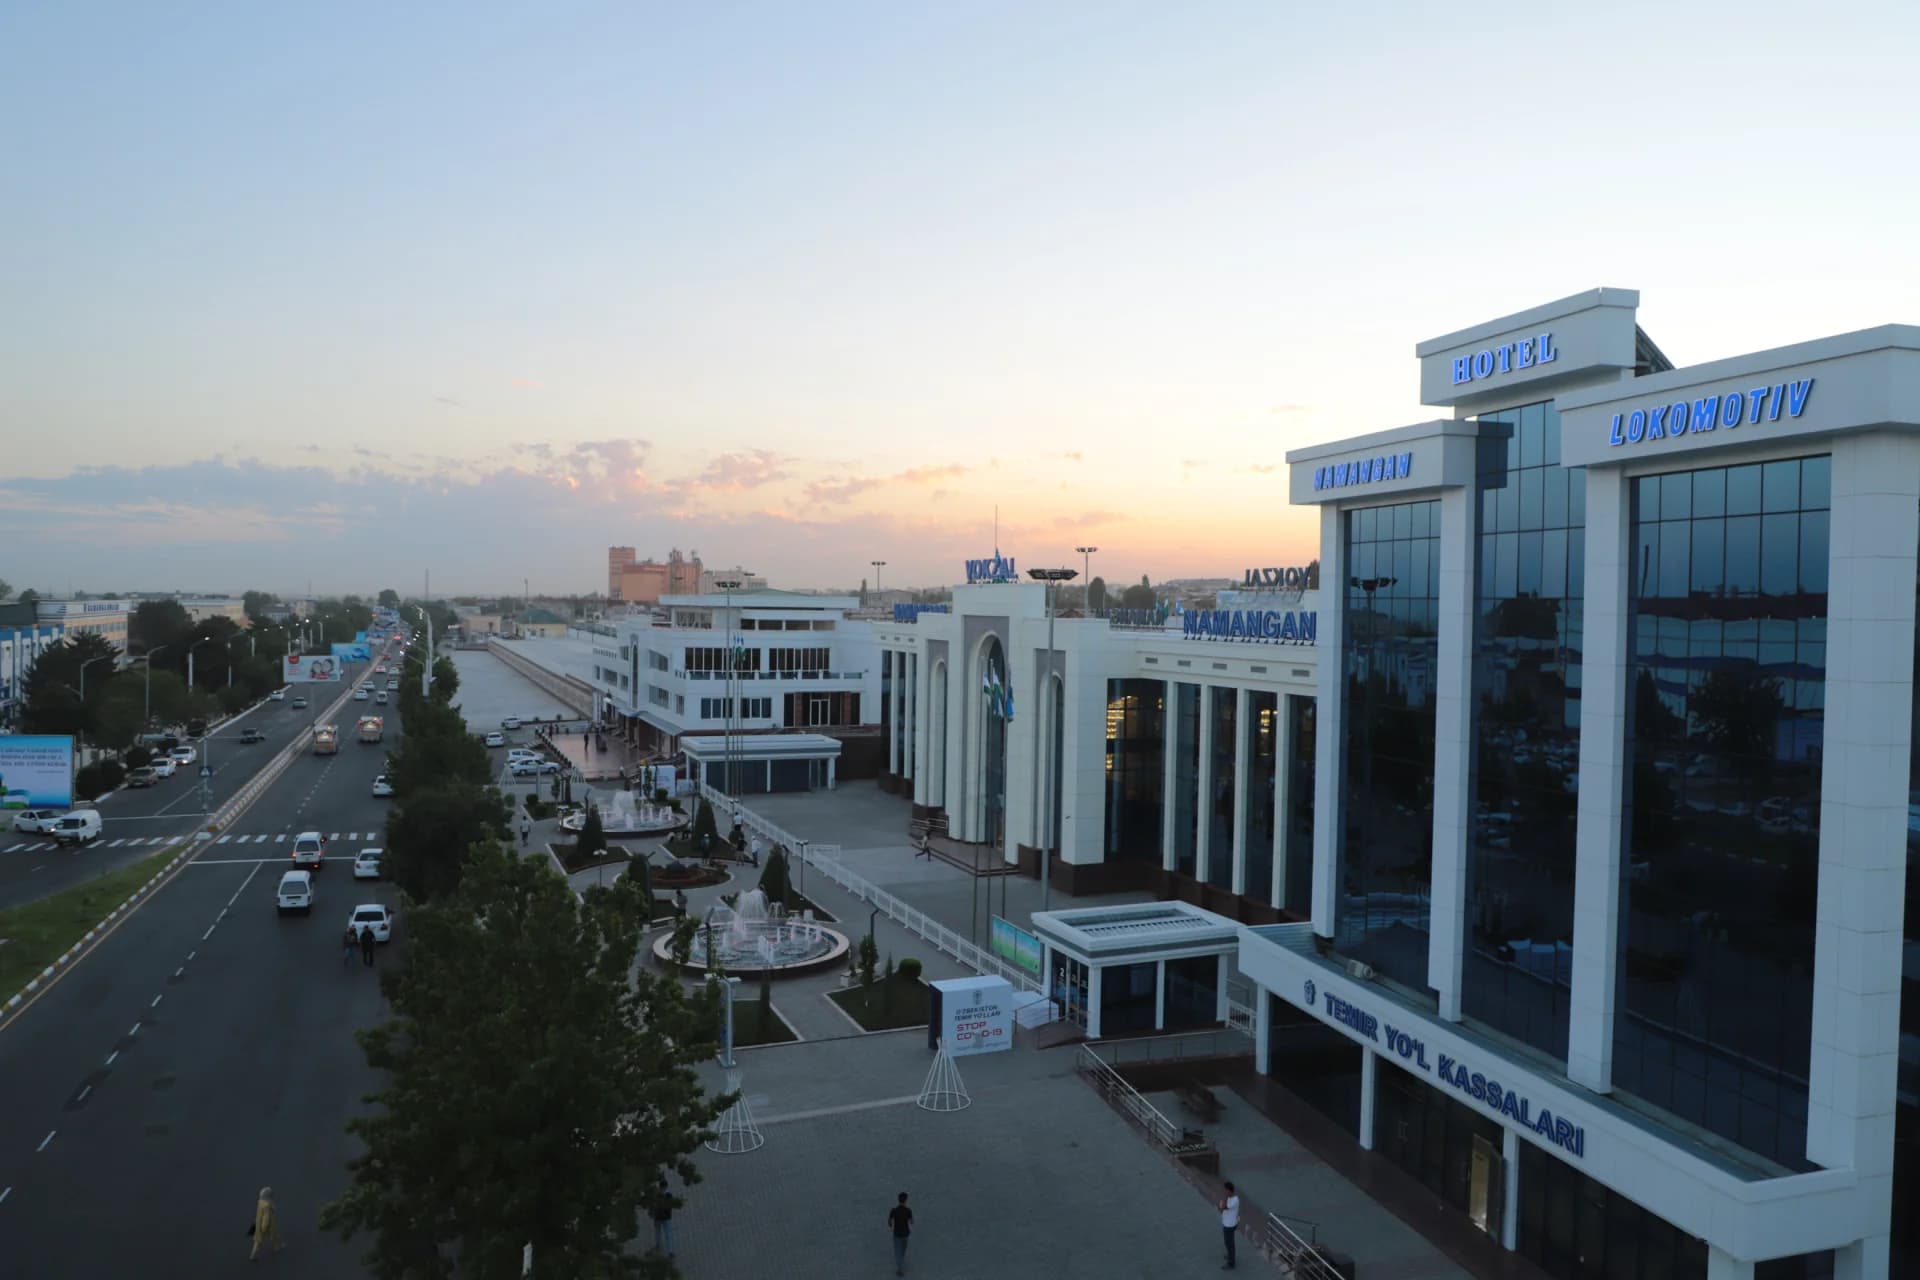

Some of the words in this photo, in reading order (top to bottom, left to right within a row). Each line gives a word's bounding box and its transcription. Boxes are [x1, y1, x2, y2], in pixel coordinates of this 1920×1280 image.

[1452, 333, 1558, 385] HOTEL
[1609, 378, 1814, 447] LOKOMOTIV
[1313, 452, 1413, 490] NAMANGAN
[1184, 608, 1318, 641] NAMANGAN
[957, 1021, 986, 1032] STOP
[1324, 991, 1379, 1042] TEMIR
[1384, 1023, 1431, 1071] YO'L
[1438, 1054, 1585, 1158] KASSALARI
